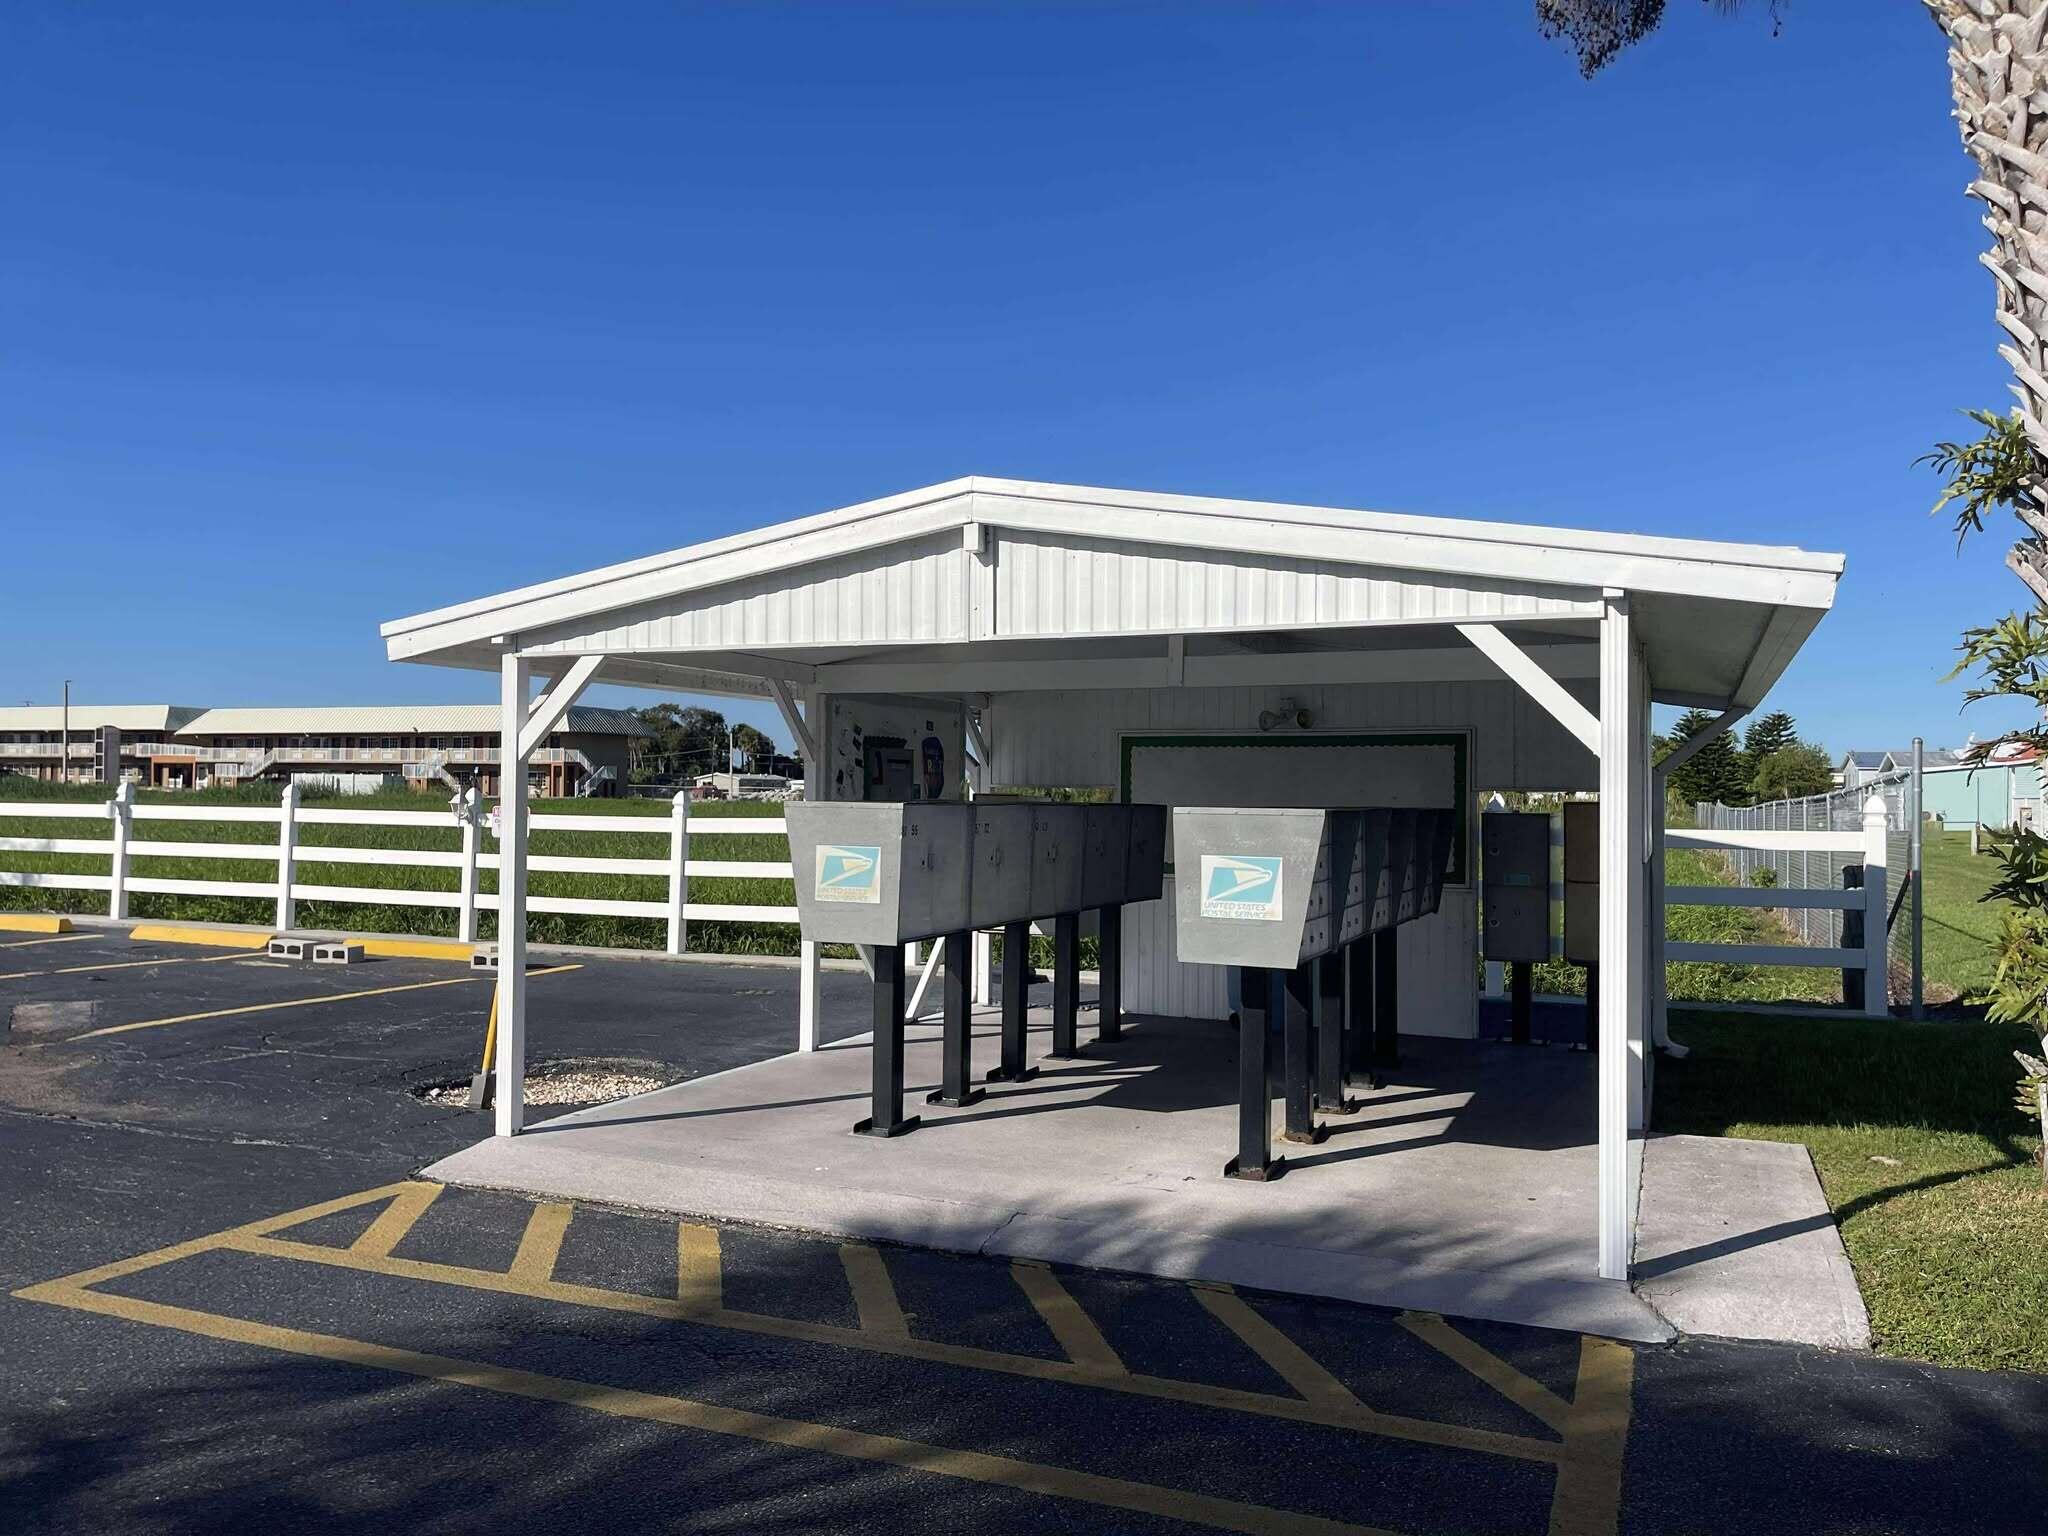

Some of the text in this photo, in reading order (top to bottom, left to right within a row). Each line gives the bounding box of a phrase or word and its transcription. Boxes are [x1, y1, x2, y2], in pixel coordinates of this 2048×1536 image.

[1203, 902, 1266, 912] UNITED STATES
[1201, 909, 1272, 919] POSTAL SERVICE
